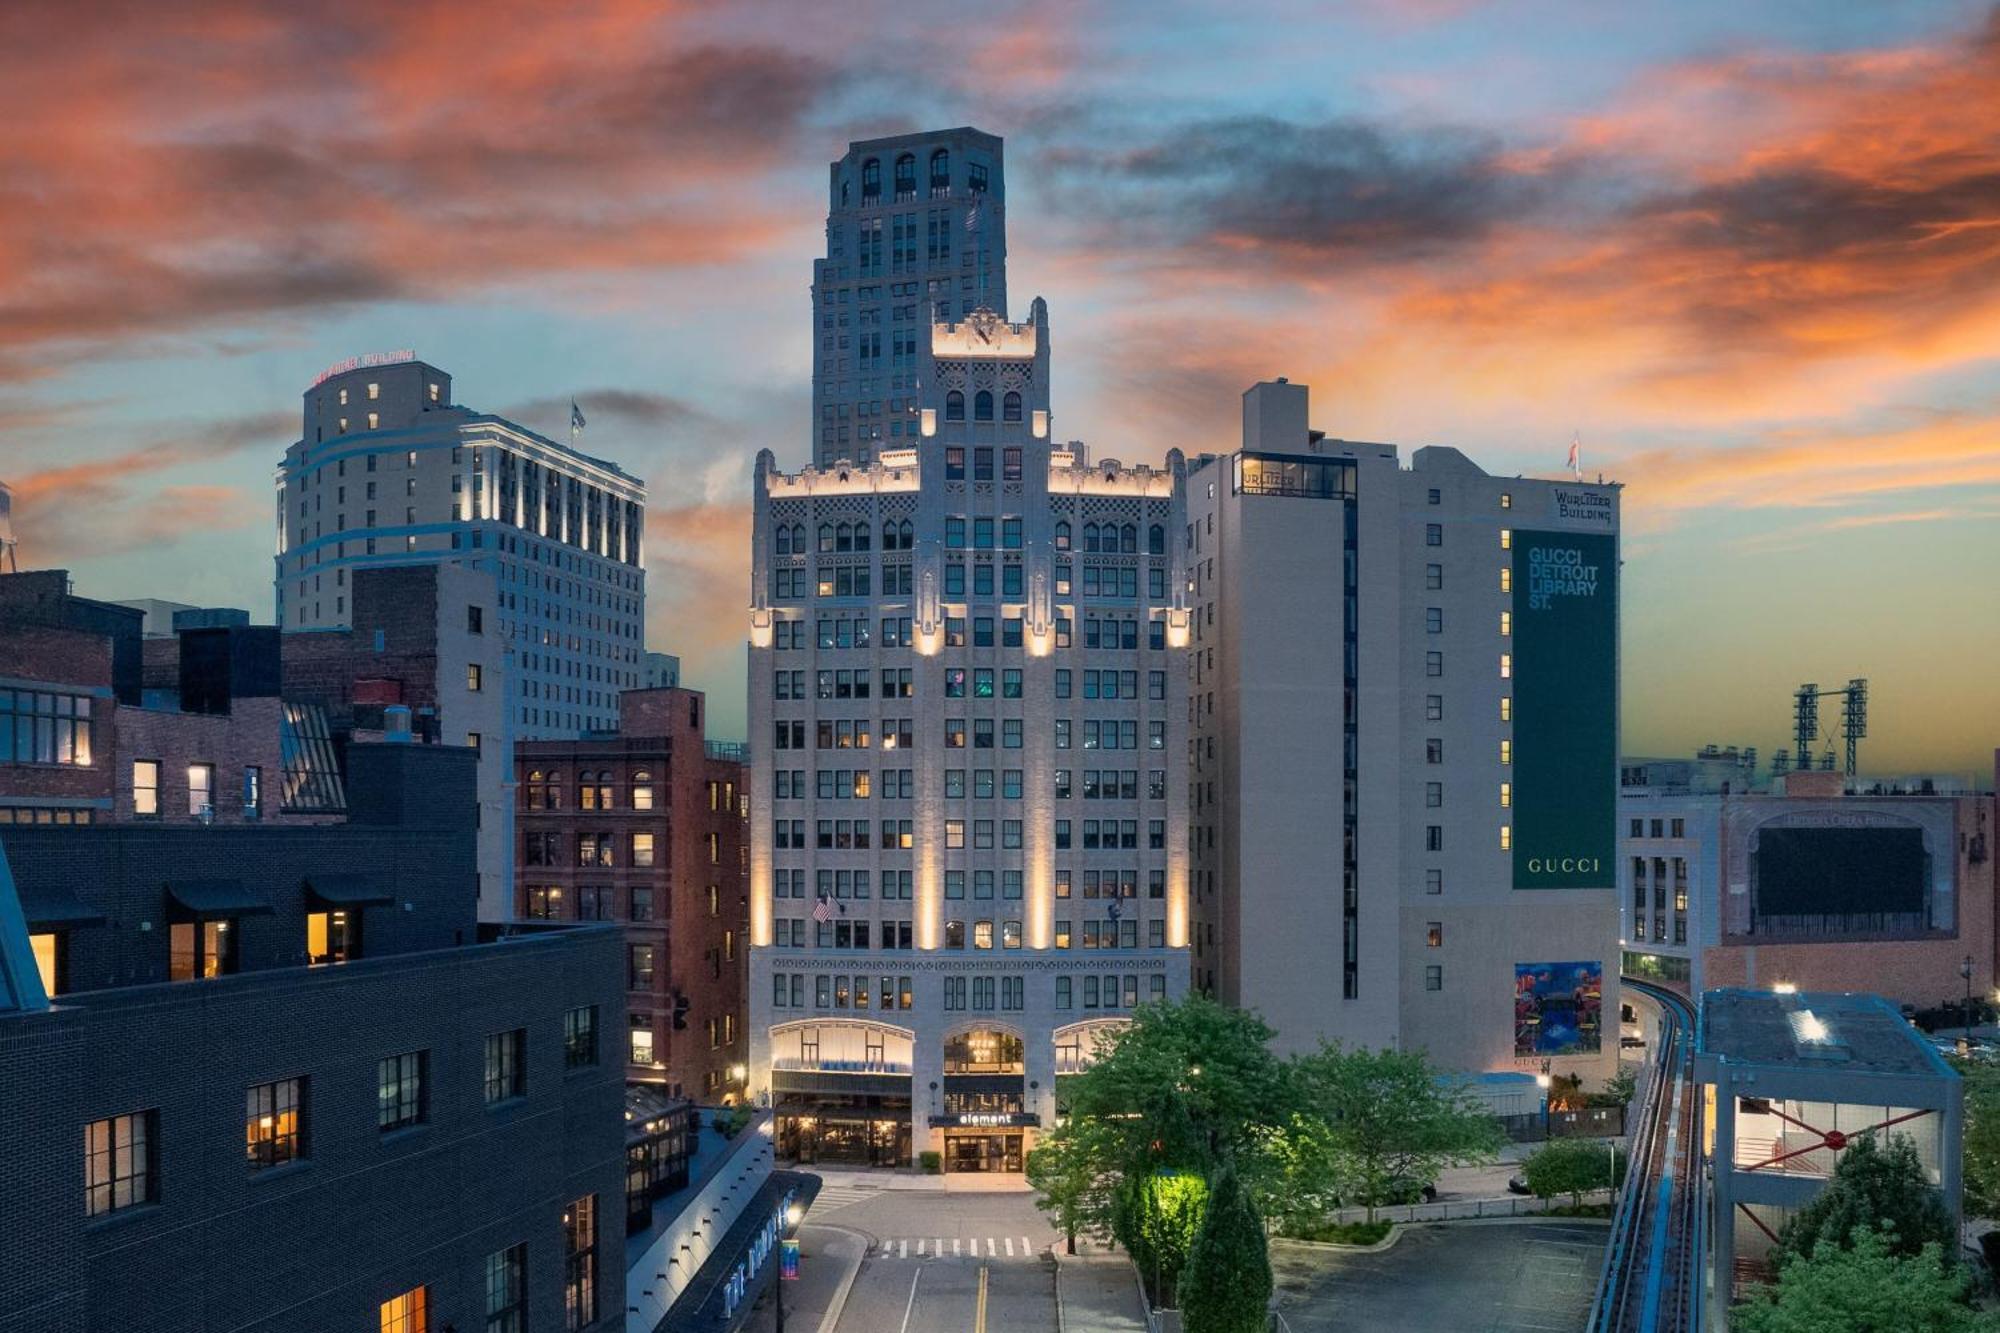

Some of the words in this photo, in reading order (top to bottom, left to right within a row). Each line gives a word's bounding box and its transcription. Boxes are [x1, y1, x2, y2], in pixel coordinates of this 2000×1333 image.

[1244, 471, 1296, 490] URLITZER
[1555, 489, 1611, 509] WURLITZER
[1560, 504, 1611, 524] BUILDING
[1529, 547, 1582, 565] GUCCI
[1529, 563, 1598, 581] DETROIT
[1529, 579, 1598, 596] LIBRARY
[1529, 594, 1552, 610] ST.
[1528, 858, 1599, 873] GUCCI
[960, 1114, 1011, 1124] element
